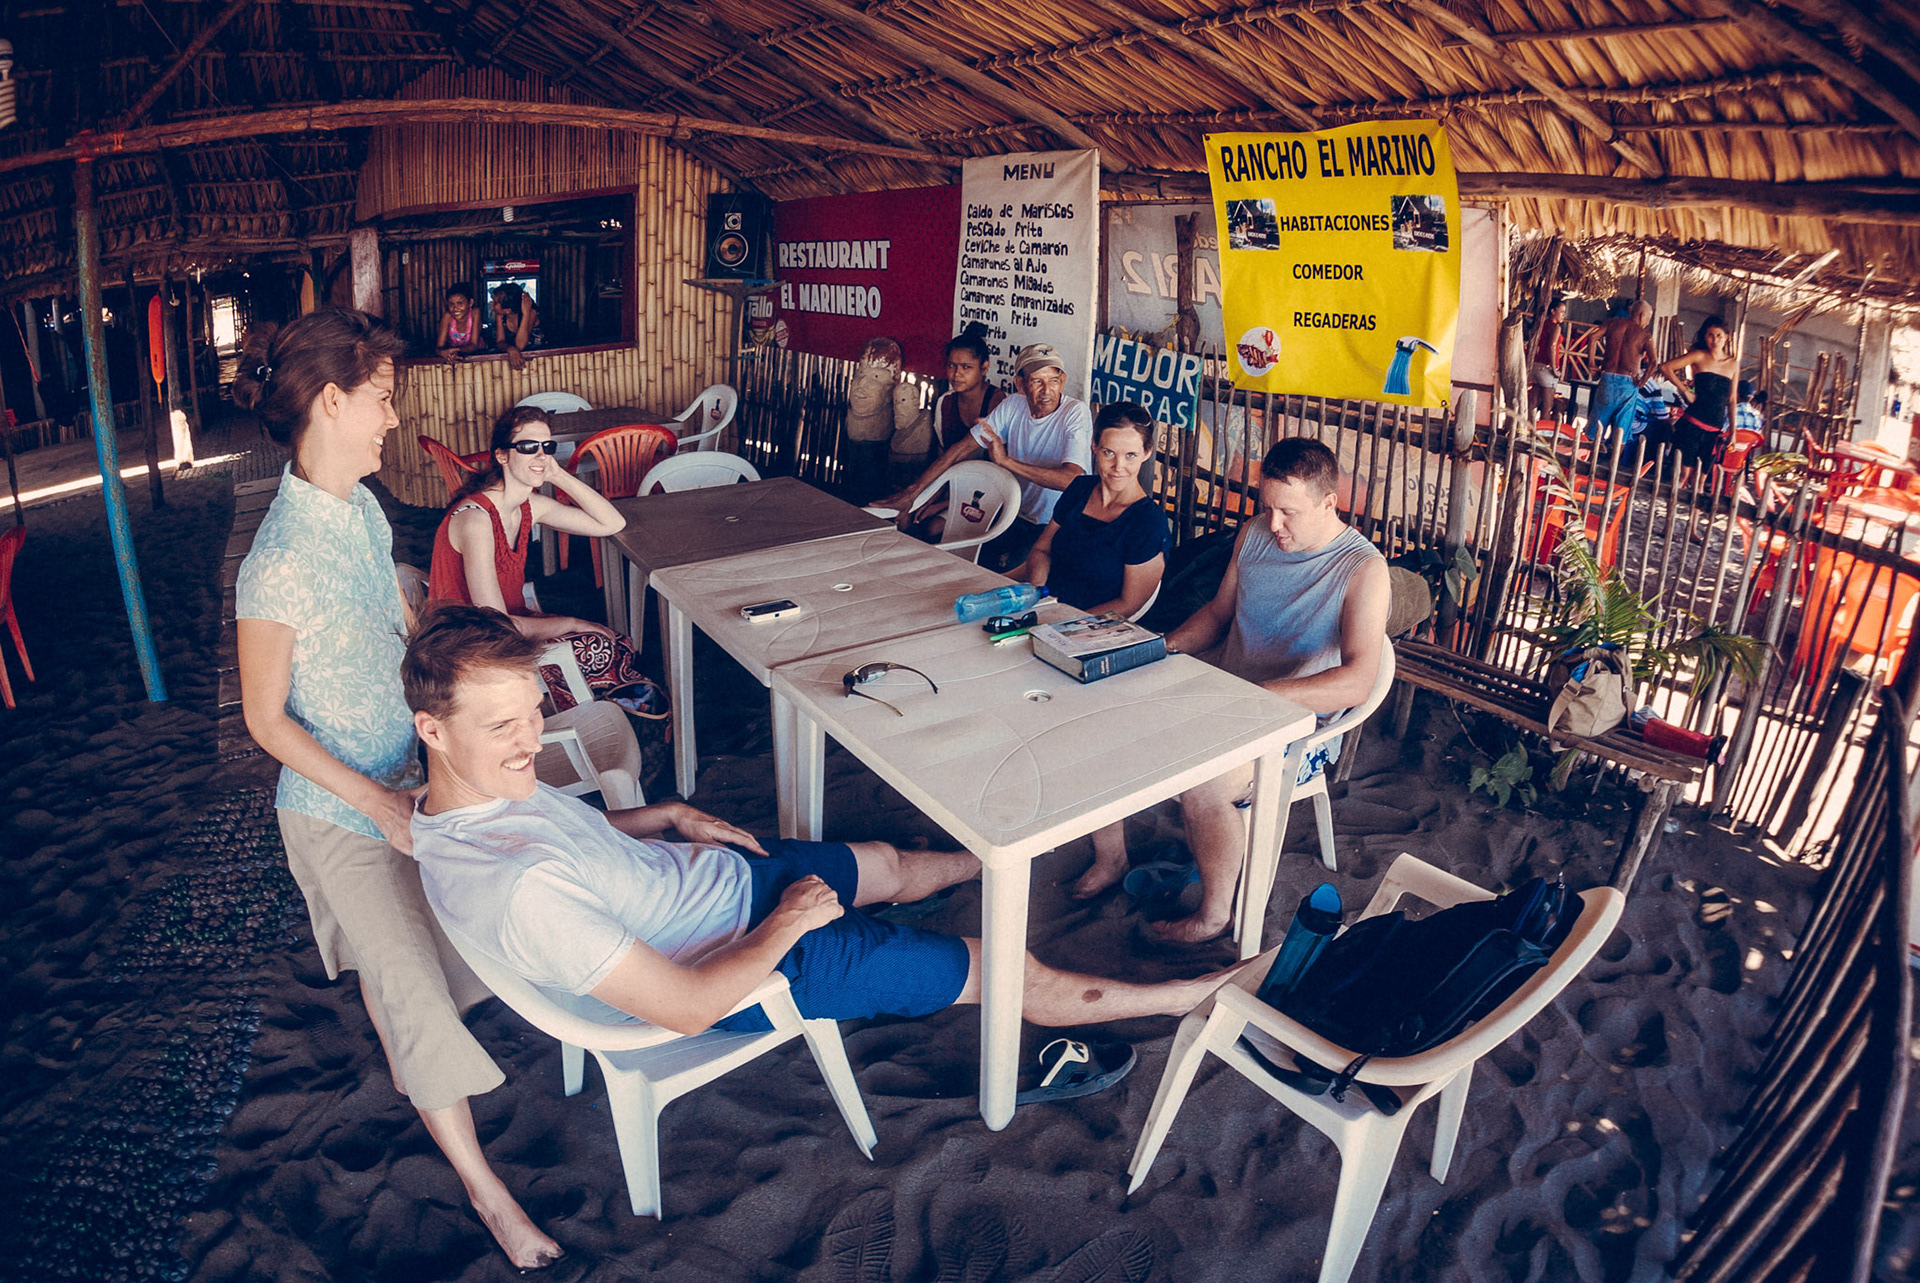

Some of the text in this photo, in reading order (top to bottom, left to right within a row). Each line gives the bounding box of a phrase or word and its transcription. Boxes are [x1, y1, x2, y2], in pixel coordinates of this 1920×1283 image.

[1221, 133, 1436, 182] RANCHO EL MARINO
[1003, 162, 1055, 181] MENU
[967, 203, 1074, 219] Caldo de Mariscos
[967, 221, 1043, 237] Pescado Frito
[1280, 215, 1390, 232] HABITACIONES
[778, 241, 890, 269] RESTAURANT
[965, 239, 1000, 254] Ceviche
[1005, 240, 1015, 254] de
[961, 254, 1011, 271] Camarones
[1013, 257, 1023, 272] al
[1292, 263, 1364, 281] COMEDOR
[960, 270, 1054, 294] Camarones Migados
[780, 283, 882, 319] EL MARINERO
[960, 287, 1005, 306] Camarones
[1293, 311, 1377, 331] REGADERAS
[987, 326, 1007, 340] rito
[1092, 333, 1200, 397] MEDOR
